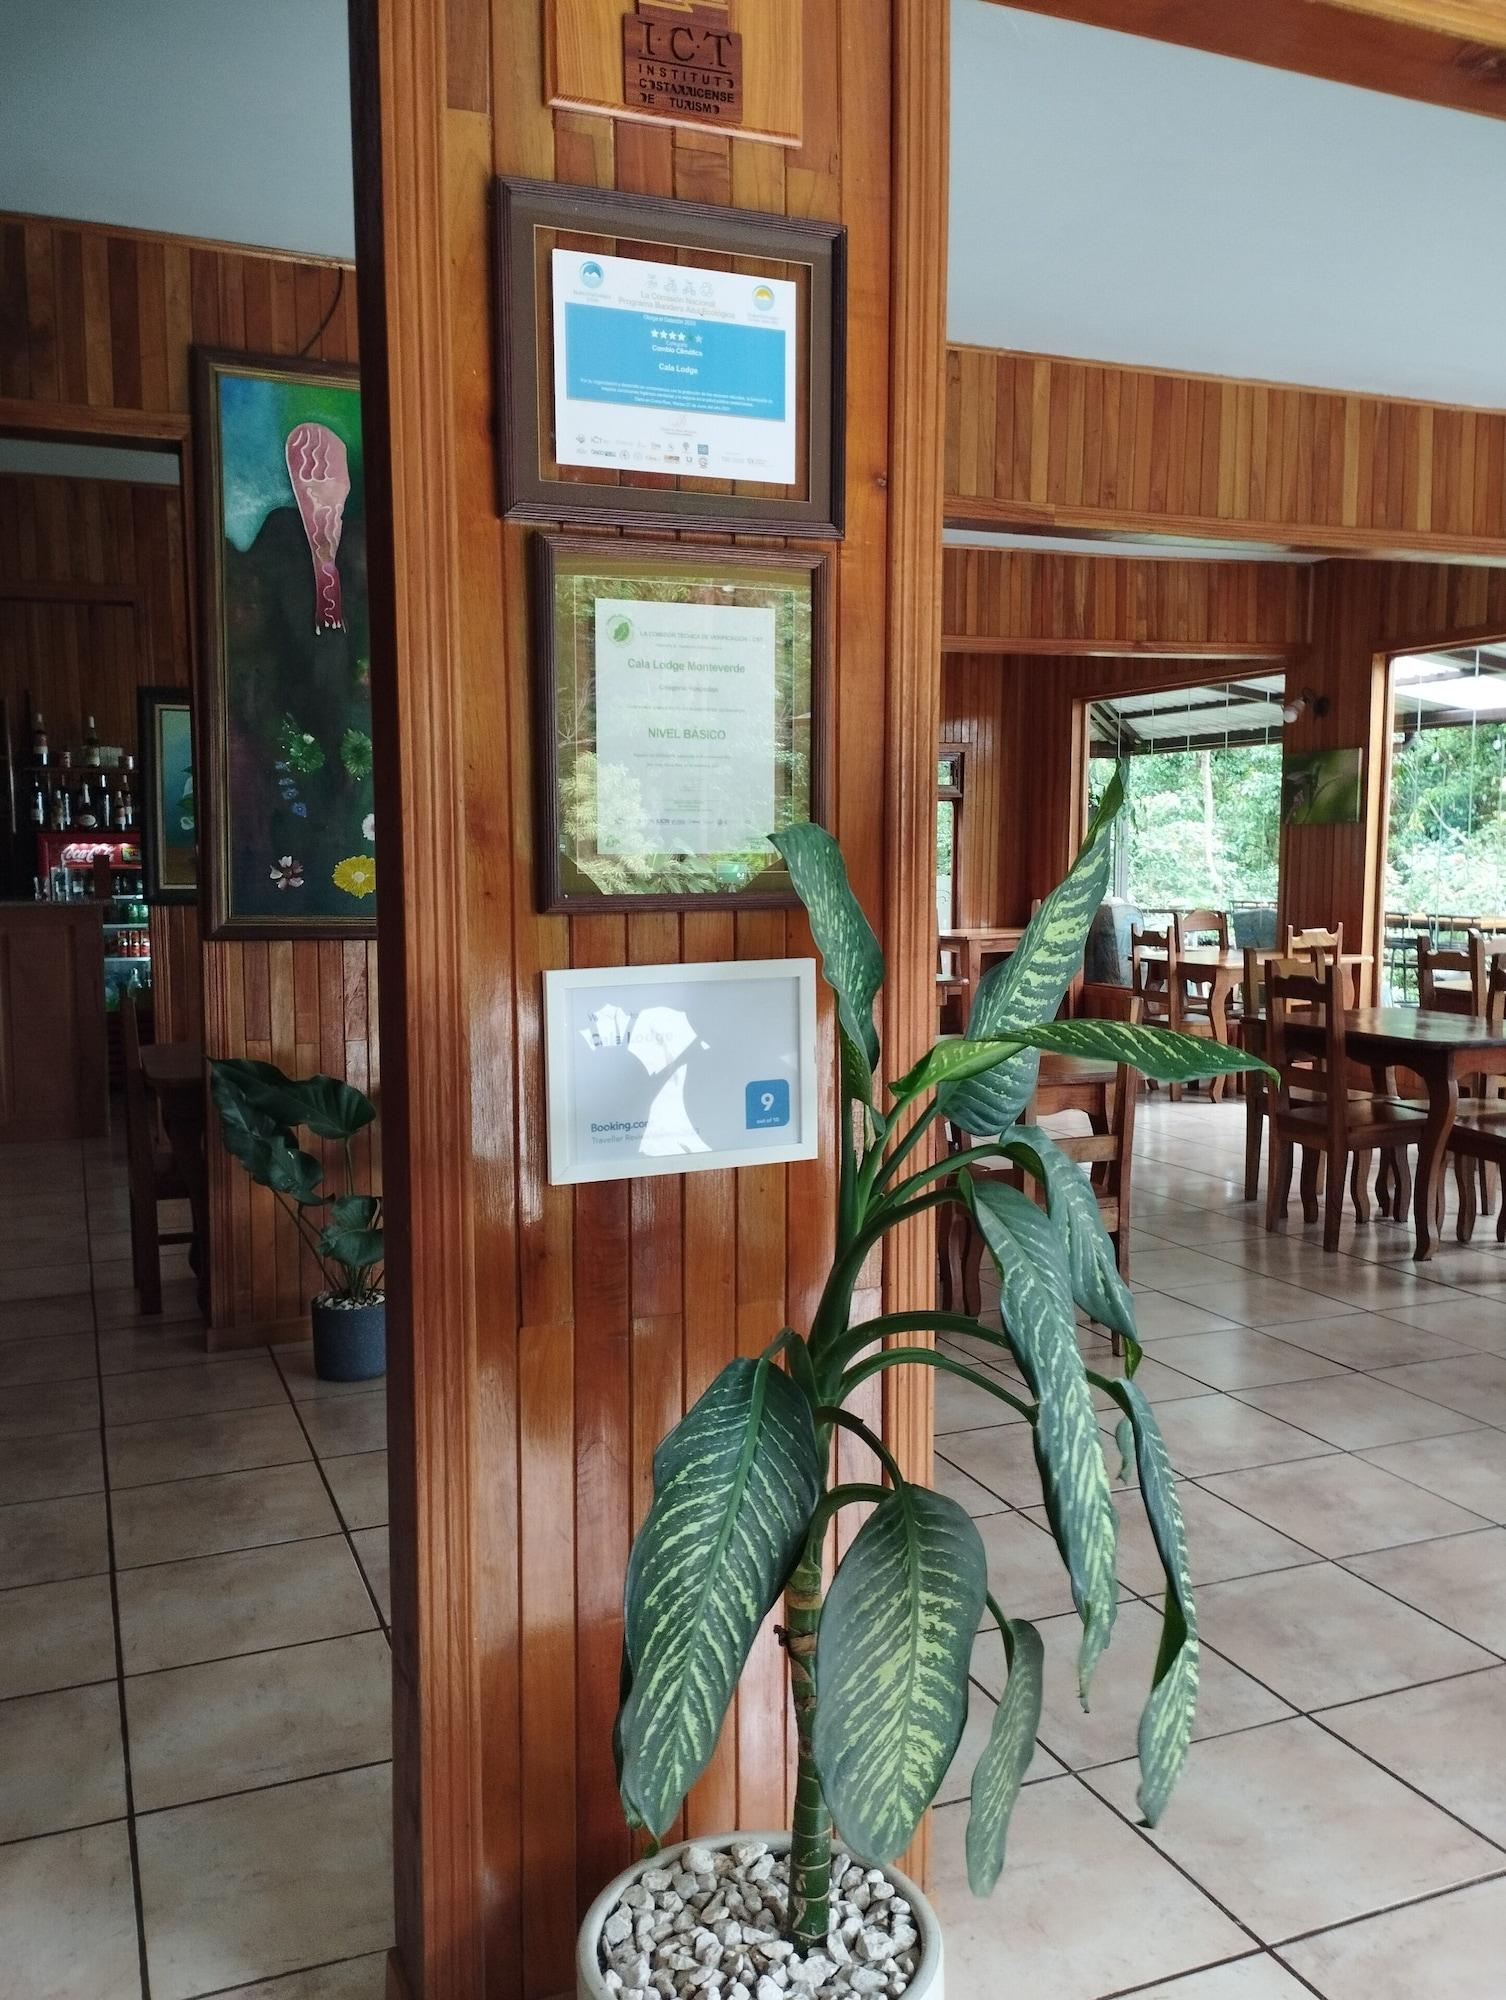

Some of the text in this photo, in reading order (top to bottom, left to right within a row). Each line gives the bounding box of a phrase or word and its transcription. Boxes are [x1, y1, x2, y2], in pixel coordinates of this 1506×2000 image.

[638, 63, 734, 89] INSTITUTO
[669, 97, 720, 115] TURISMO
[675, 365, 699, 375] Lodge
[627, 658, 745, 673] Cala Lodge Monteverde
[648, 728, 680, 739] NIVEL
[760, 1092, 775, 1111] 9
